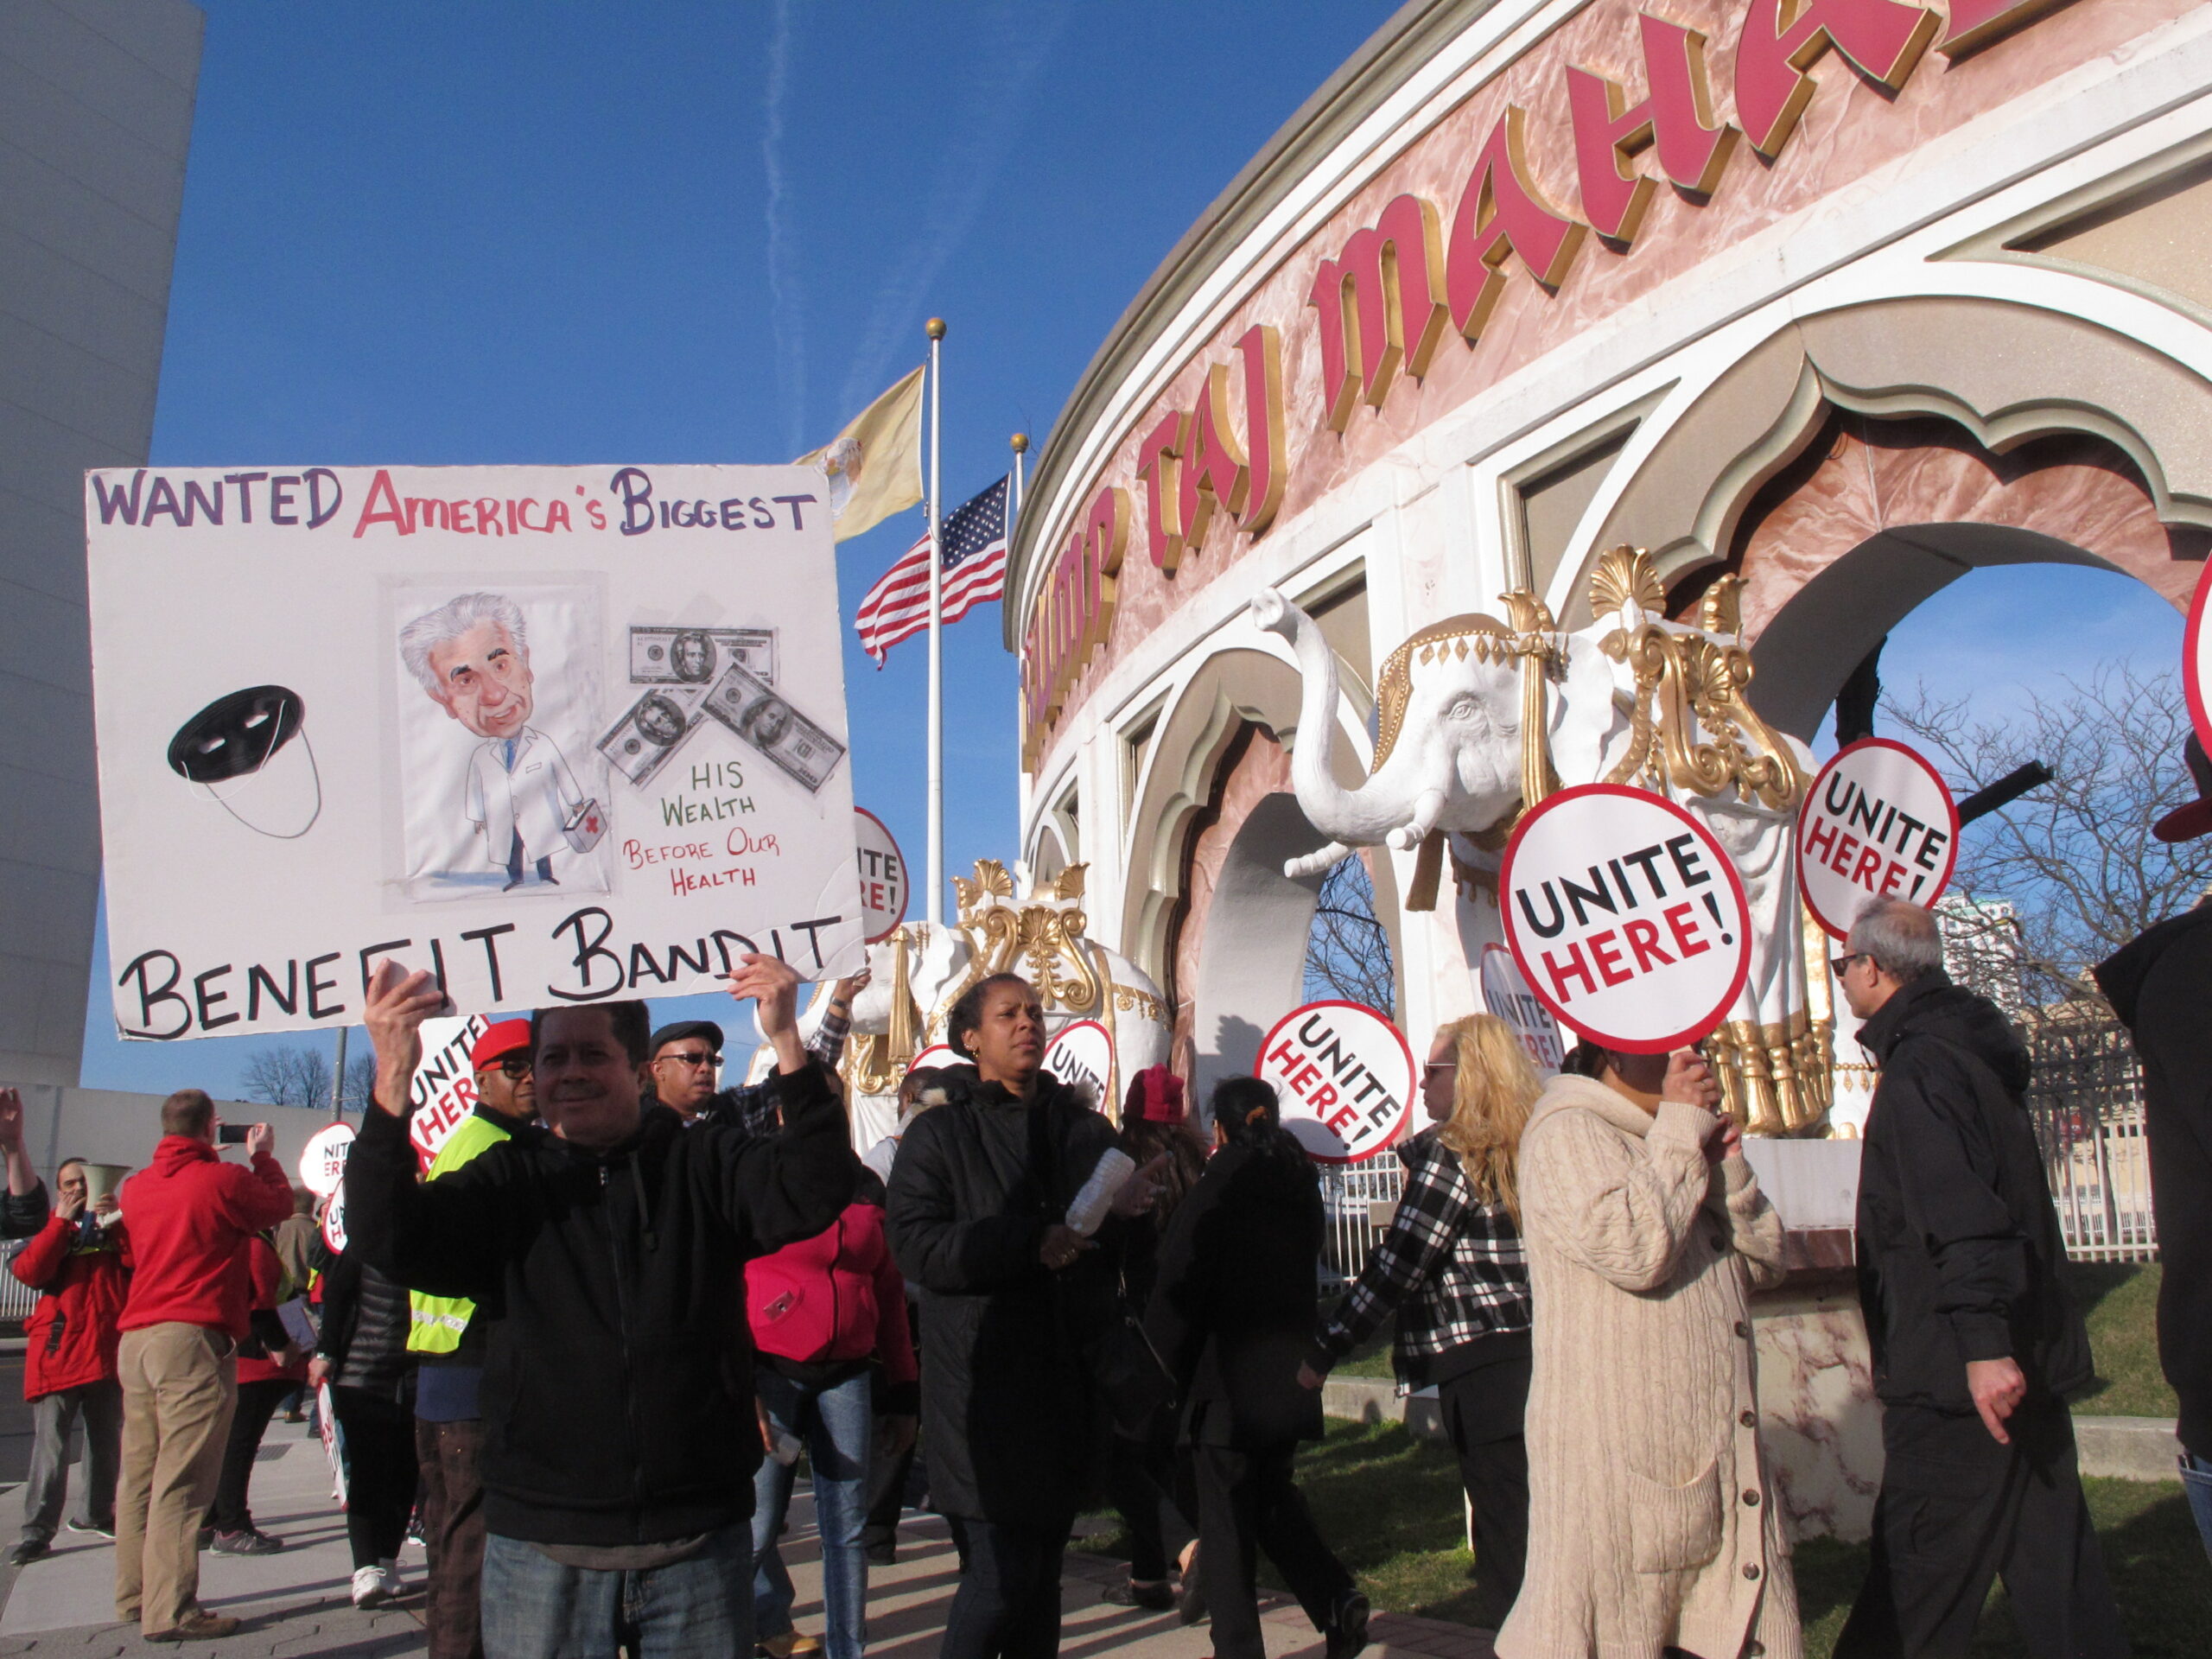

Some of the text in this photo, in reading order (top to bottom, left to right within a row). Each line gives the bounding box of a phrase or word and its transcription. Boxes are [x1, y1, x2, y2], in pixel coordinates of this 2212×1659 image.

[1020, 0, 2072, 772] RUMP TAJ MAHA
[92, 467, 343, 530] WANTED
[610, 467, 817, 537] BIGGEST
[661, 794, 756, 827] WEALTH
[692, 760, 744, 791] HIS
[623, 827, 780, 870] BEFORE OUR
[1824, 770, 1948, 872] UNITE
[671, 868, 756, 897] HEALTH
[857, 847, 899, 883] ITE
[1516, 832, 1712, 938] UNITE
[548, 906, 842, 1001] BANDIT
[1541, 891, 1733, 1005] HERE!
[1268, 1039, 1373, 1151] HERE!
[1298, 1013, 1402, 1128] UNITE
[416, 1077, 480, 1147] HER
